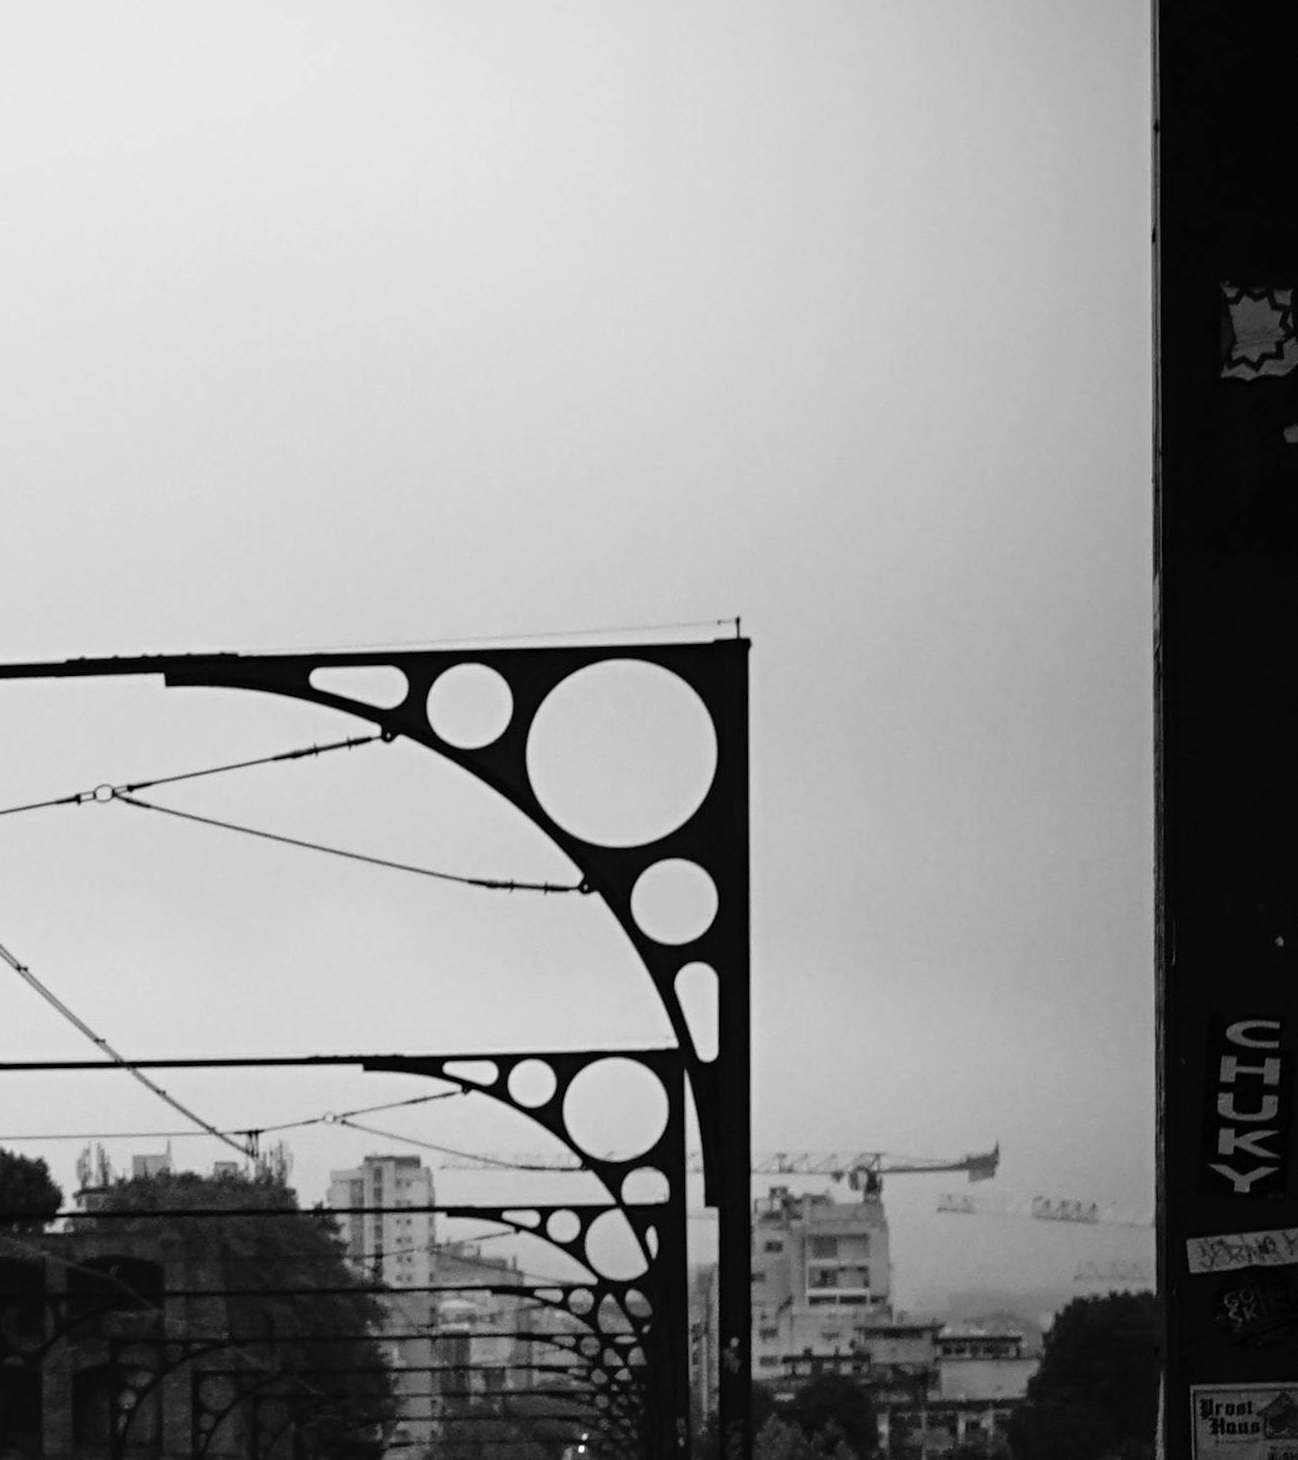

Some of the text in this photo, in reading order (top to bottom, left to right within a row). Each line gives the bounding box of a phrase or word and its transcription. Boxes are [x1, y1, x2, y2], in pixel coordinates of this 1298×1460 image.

[1207, 1020, 1281, 1193] CHUKY
[1200, 1398, 1253, 1420] Prost
[1210, 1417, 1261, 1436] Haus
